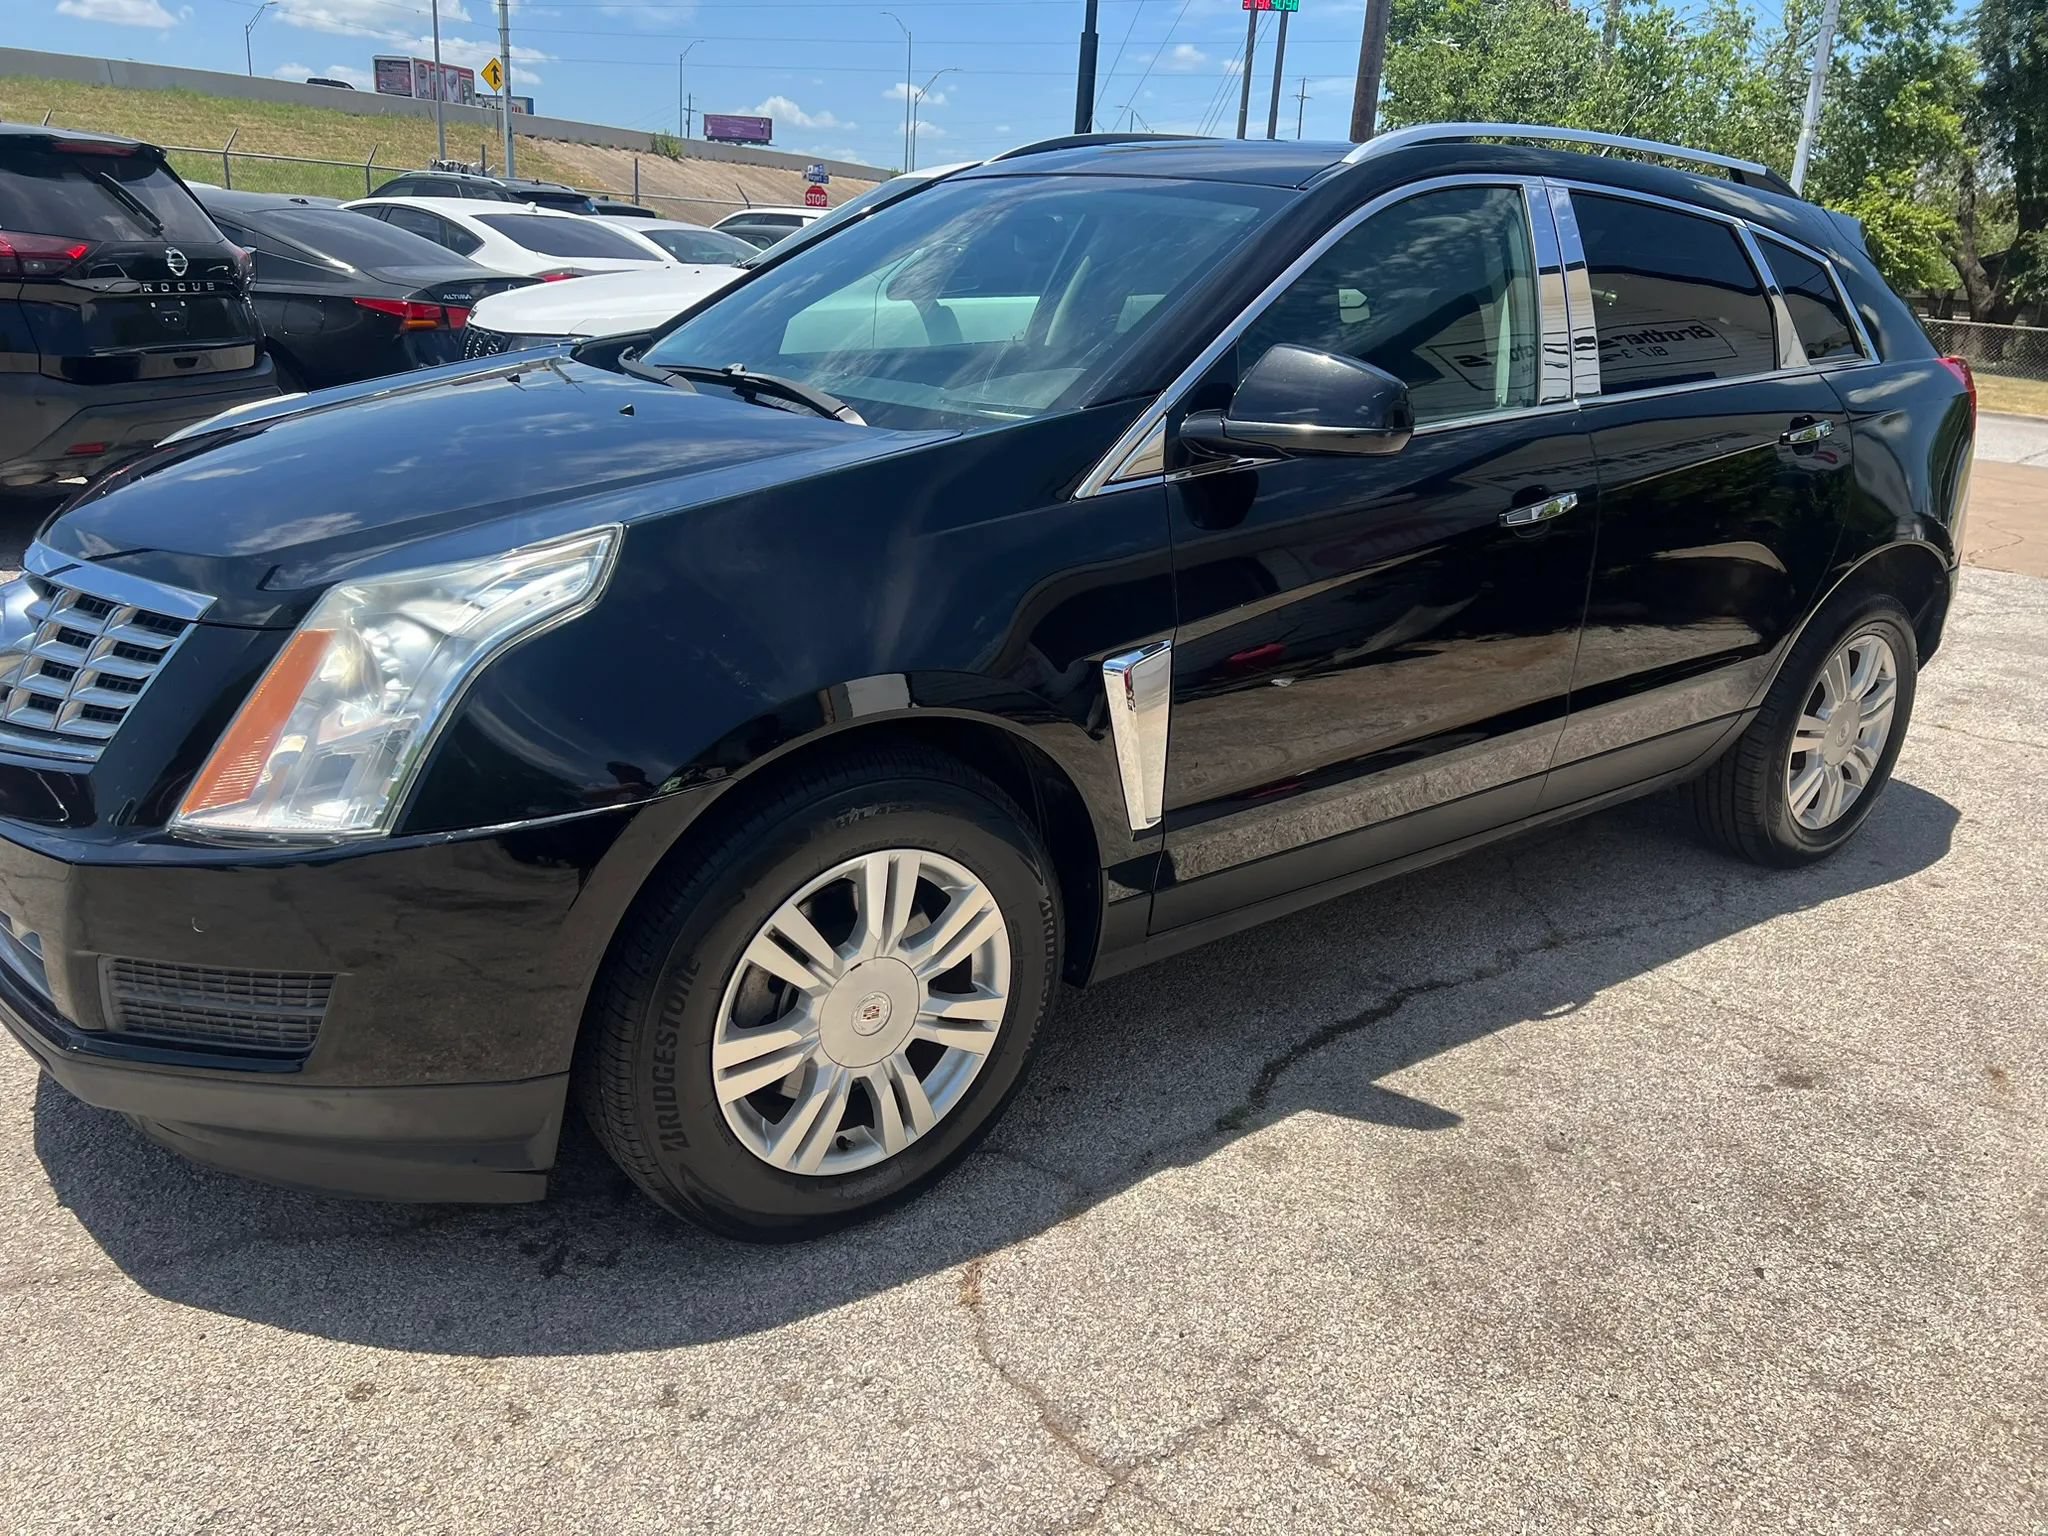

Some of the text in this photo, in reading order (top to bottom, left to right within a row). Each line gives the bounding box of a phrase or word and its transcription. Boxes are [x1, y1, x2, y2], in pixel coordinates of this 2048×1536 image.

[806, 193, 827, 206] STOP
[142, 282, 215, 292] ROGUE
[652, 954, 702, 1153] BRIDGESTONE
